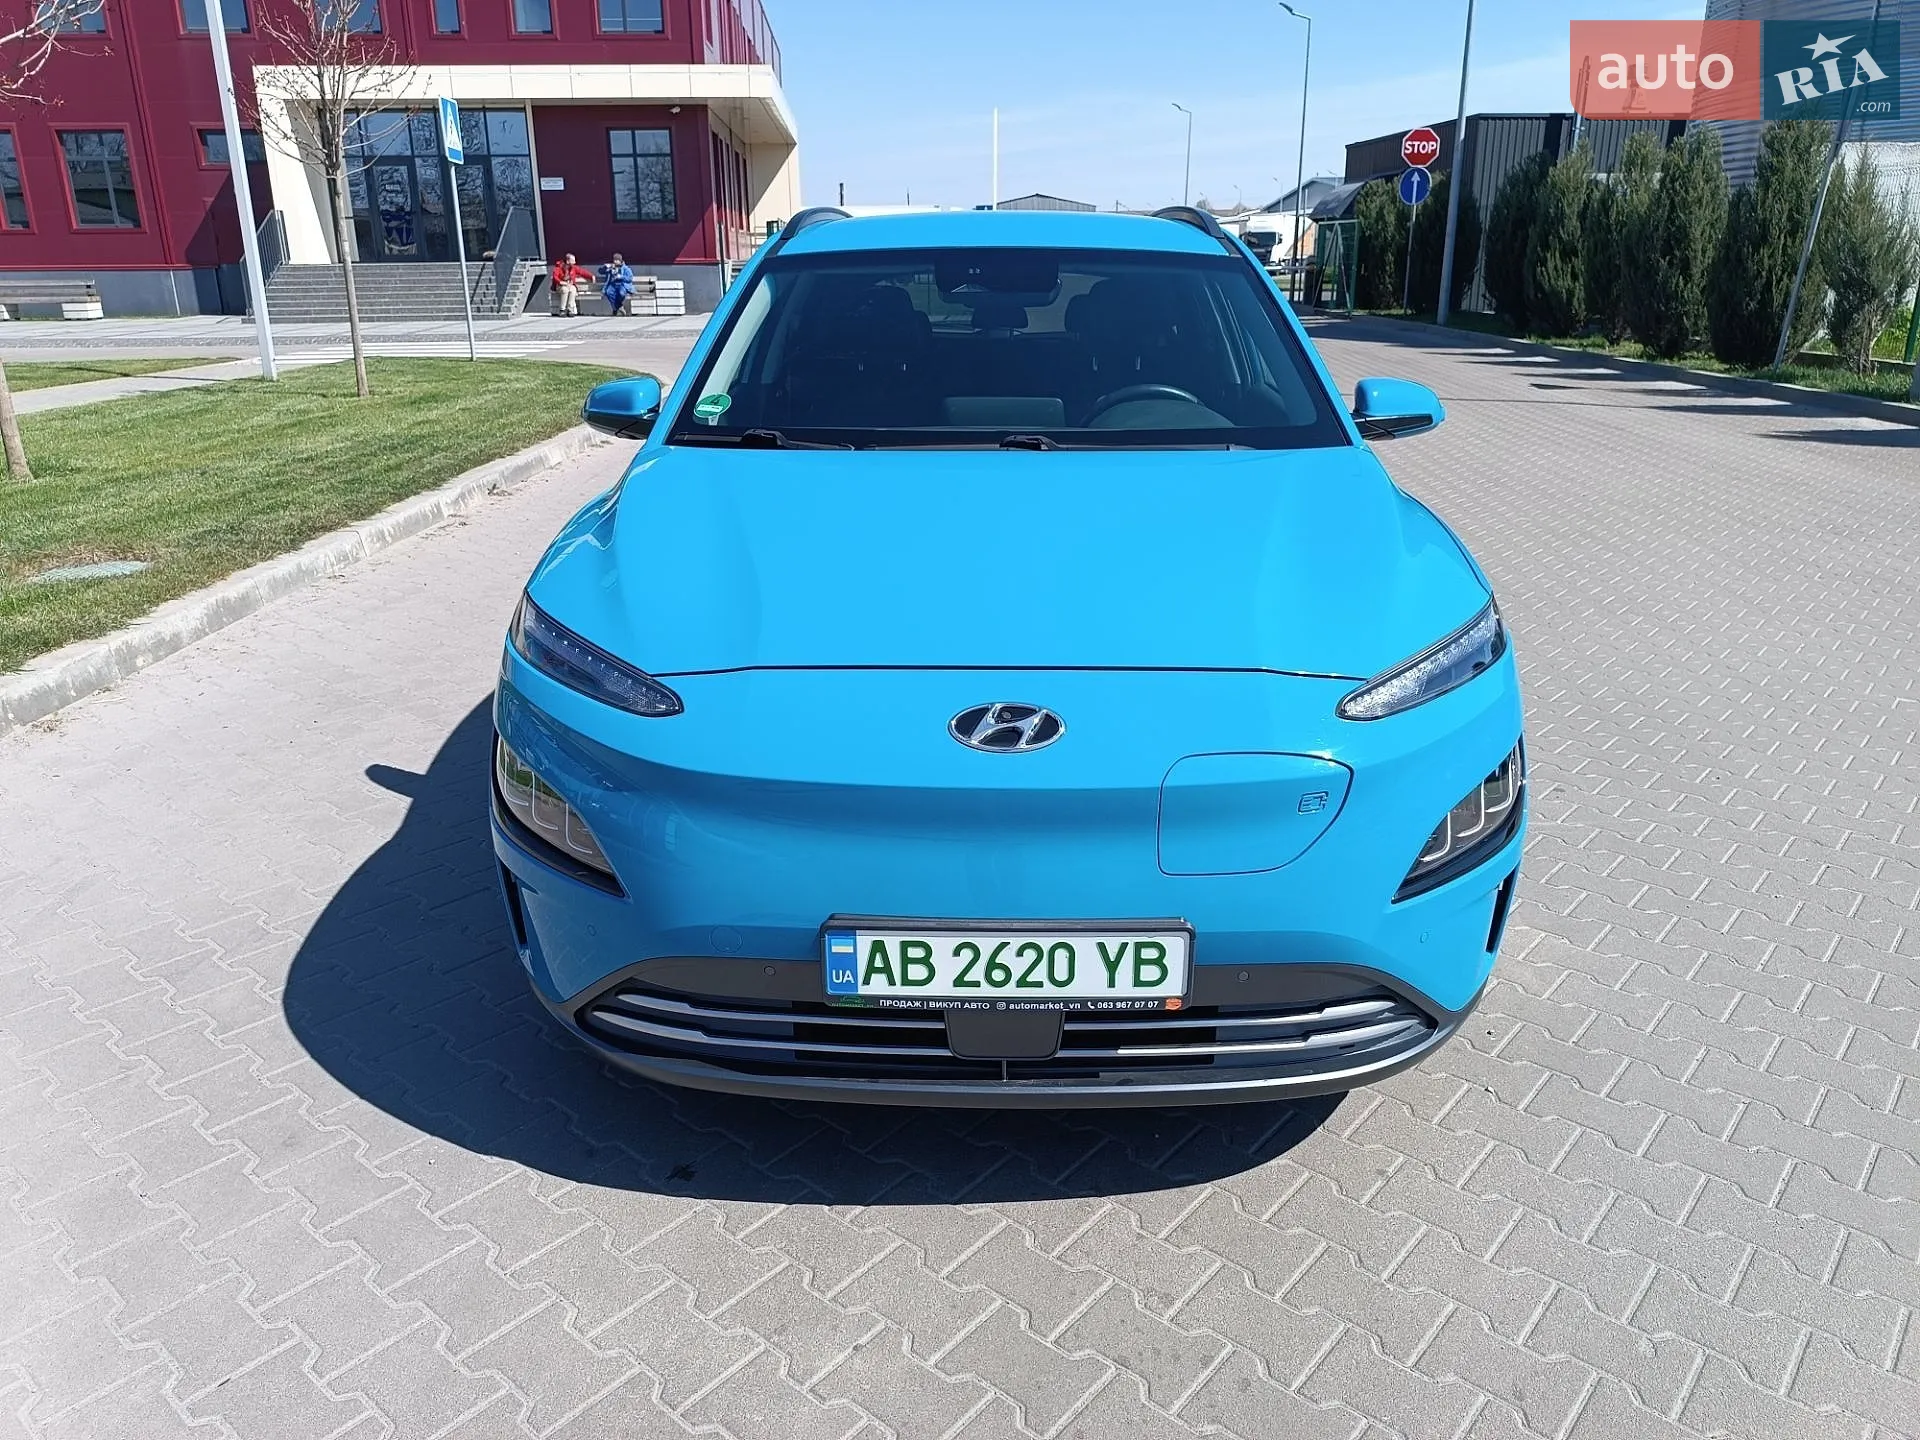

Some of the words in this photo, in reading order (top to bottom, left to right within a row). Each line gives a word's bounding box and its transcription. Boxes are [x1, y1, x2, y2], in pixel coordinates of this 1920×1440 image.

[1404, 141, 1437, 154] STOP
[862, 940, 936, 987] AB
[952, 941, 1076, 988] 2620
[1097, 941, 1169, 988] YB
[833, 969, 855, 984] UA
[879, 999, 922, 1008] ПРОДАЖ
[929, 1001, 961, 1009] ВИКУП
[1008, 1001, 1081, 1011] automarket_vn
[1097, 1001, 1114, 1009] 063
[1134, 1001, 1145, 1009] 07
[1147, 1001, 1159, 1009] 07
